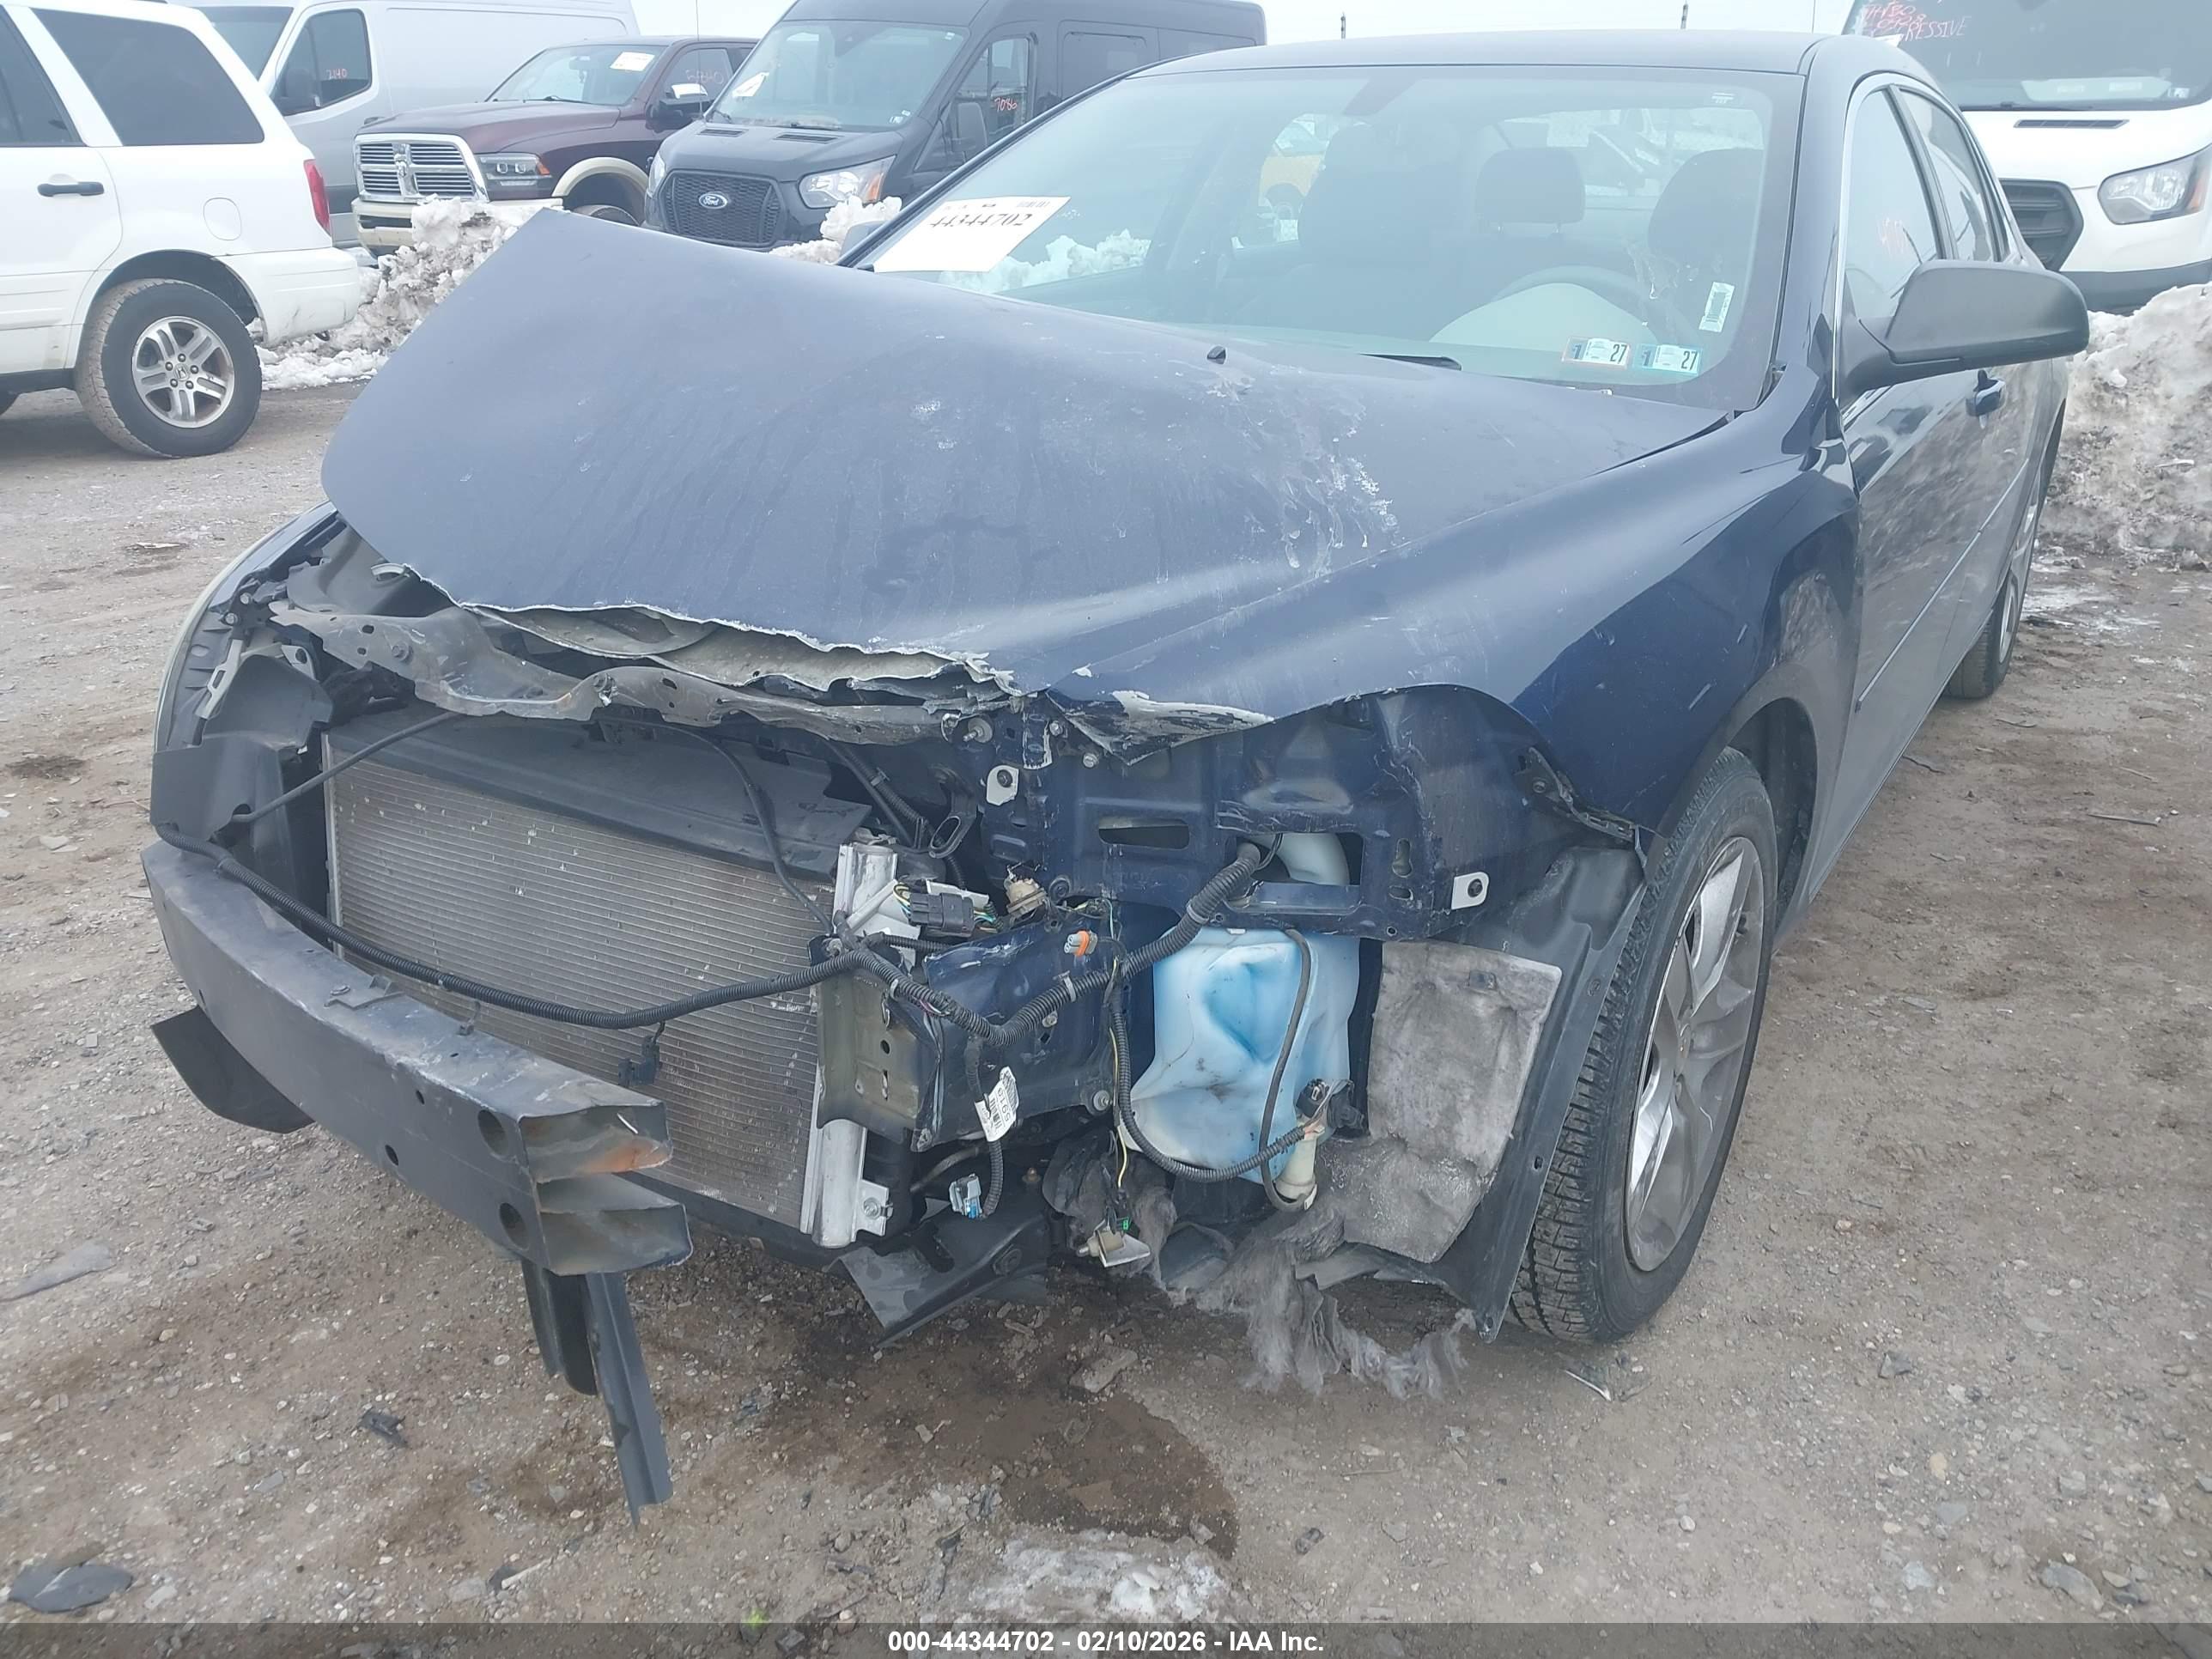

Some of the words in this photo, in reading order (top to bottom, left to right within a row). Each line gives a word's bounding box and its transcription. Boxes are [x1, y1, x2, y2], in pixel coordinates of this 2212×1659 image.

[994, 97, 1018, 112] 7086
[930, 213, 1033, 228] 44344702
[1609, 343, 1627, 364] 27
[1680, 350, 1698, 372] 27
